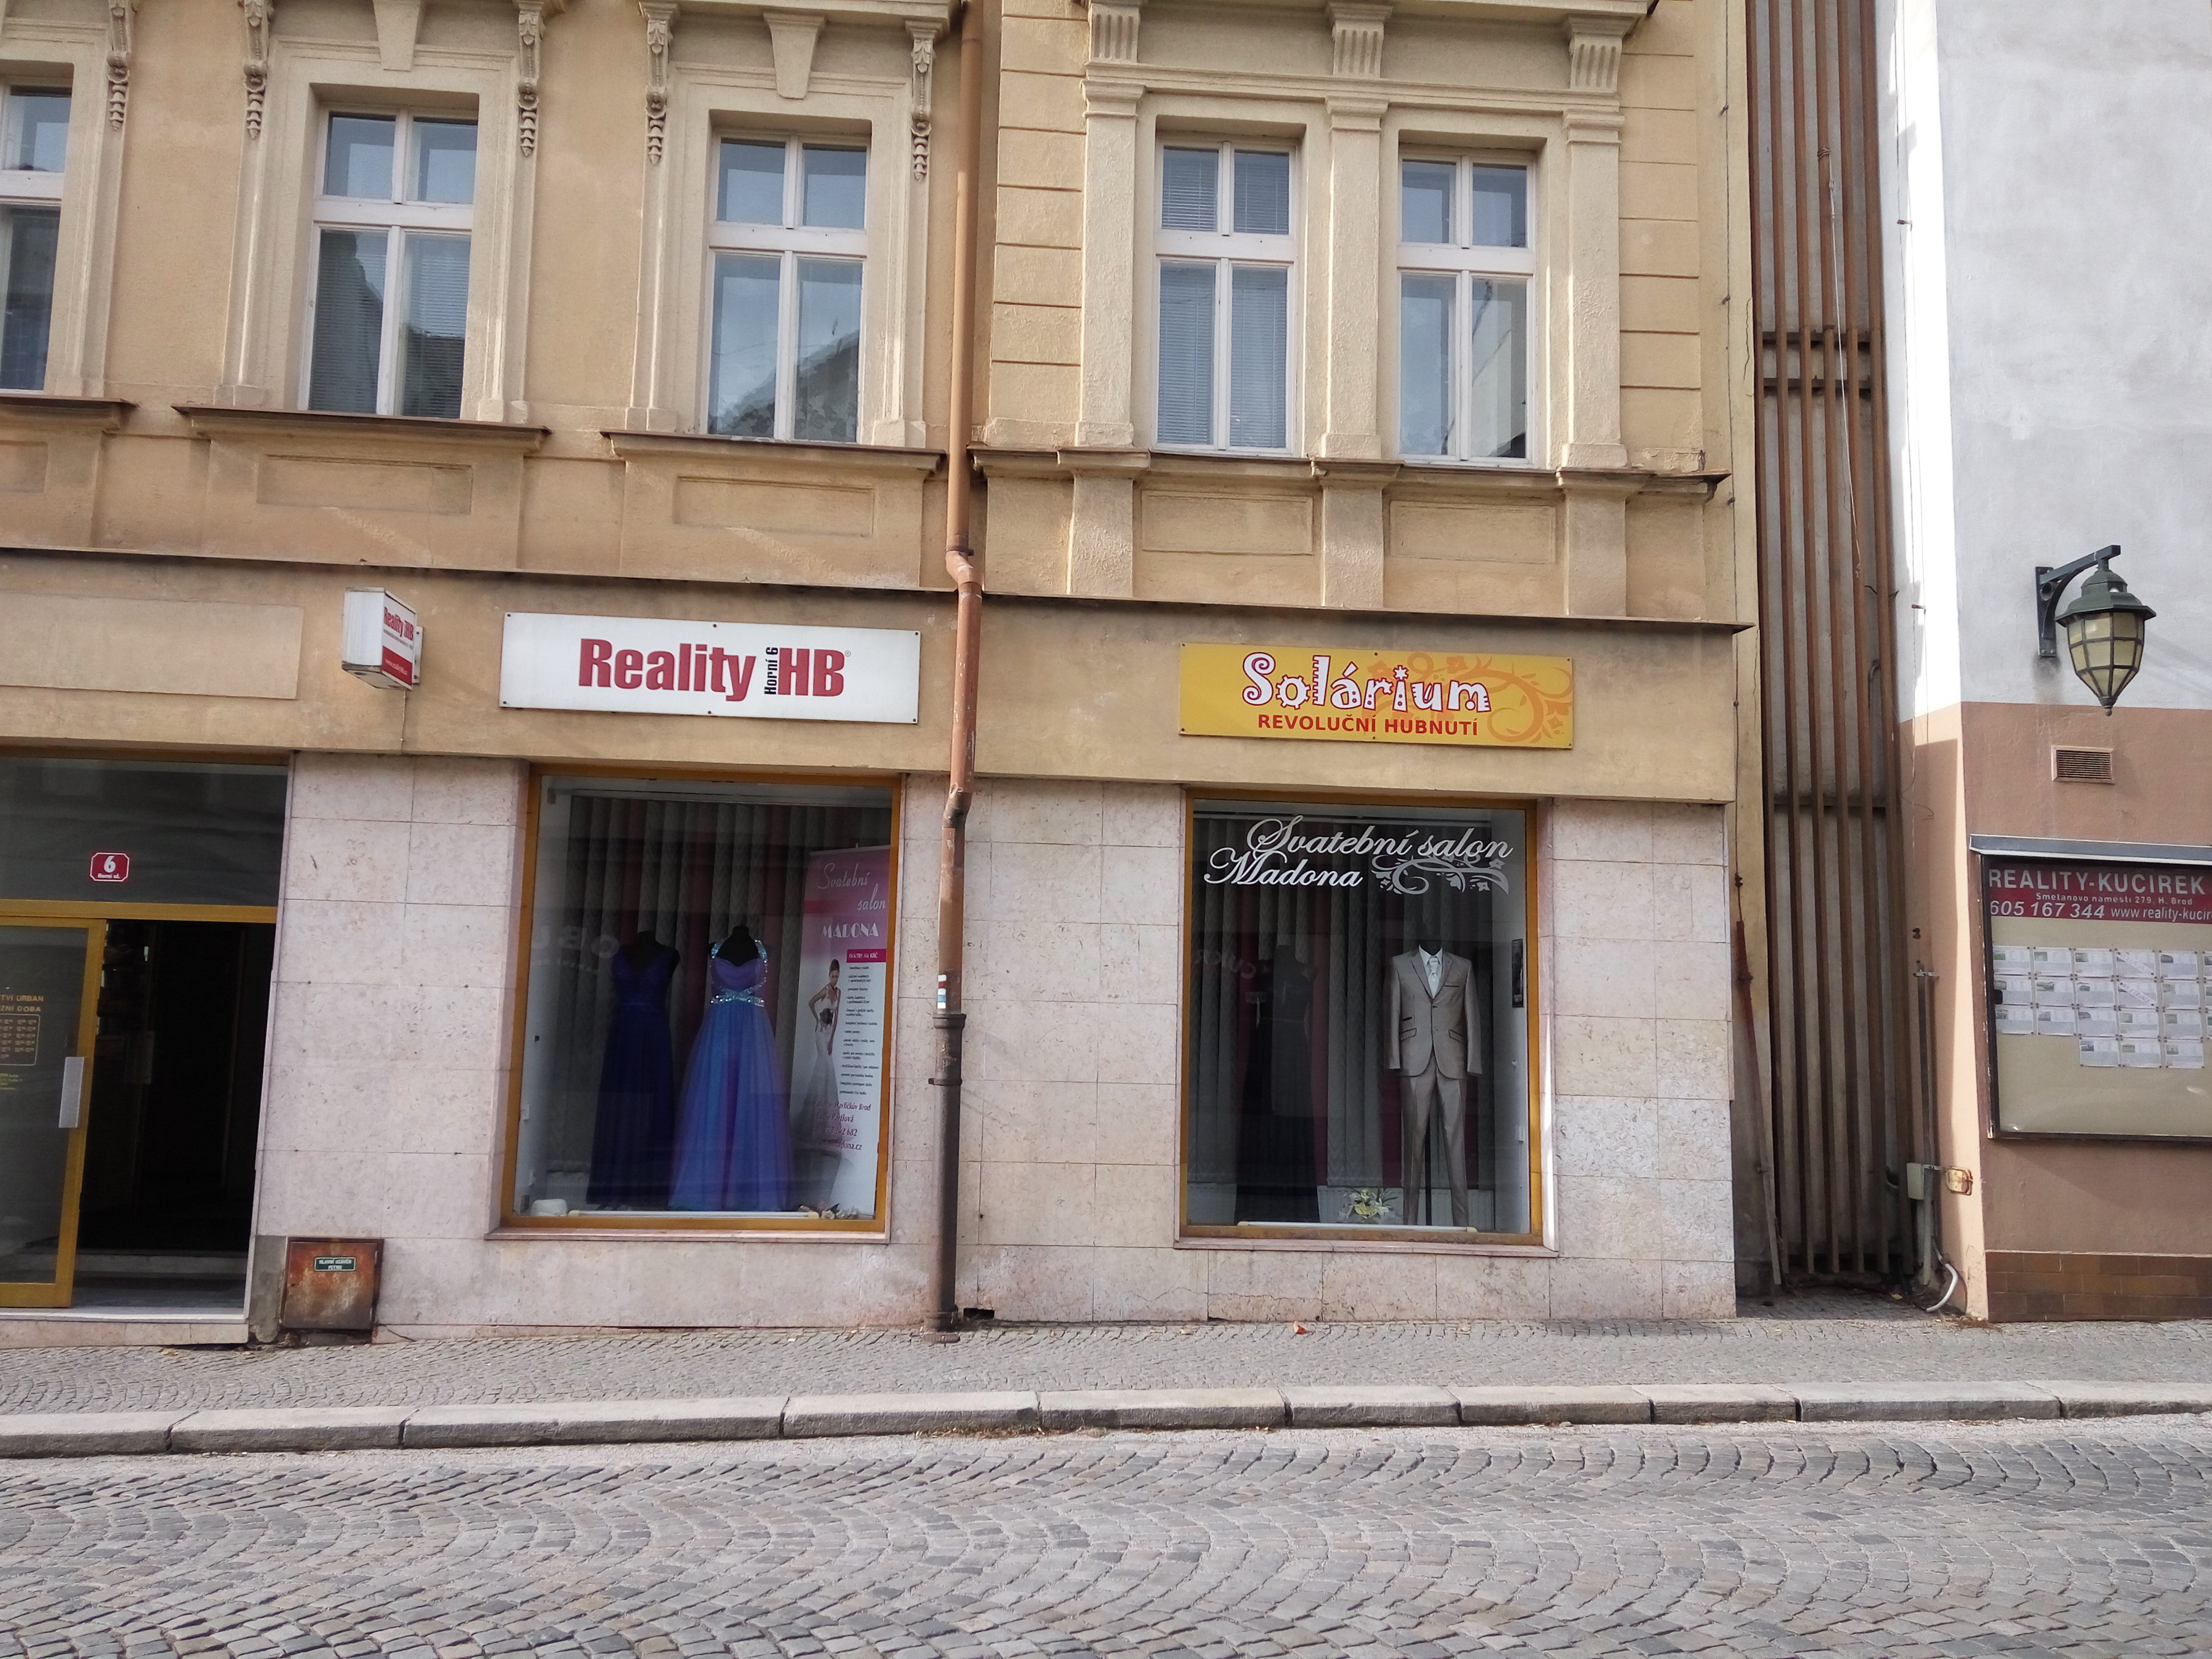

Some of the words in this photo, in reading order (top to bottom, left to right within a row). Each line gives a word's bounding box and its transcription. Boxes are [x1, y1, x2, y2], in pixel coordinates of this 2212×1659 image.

[383, 607, 404, 637] Reality
[578, 638, 756, 702] Reality
[778, 648, 845, 697] HB
[764, 659, 778, 695] Horní
[1242, 651, 1492, 713] Solárium
[1258, 713, 1376, 733] REVOLUČNÍ
[1384, 717, 1478, 736] HUBNUTÍ
[1246, 815, 1418, 857] Svatební
[1418, 828, 1514, 858] salon
[103, 855, 116, 873] 6
[817, 863, 870, 889] Svatební
[1204, 847, 1364, 887] Madona
[857, 883, 886, 910] salon
[2171, 897, 2193, 905] Brod
[1990, 900, 2025, 916] 605
[2031, 901, 2065, 917] 167
[2070, 903, 2105, 919] 344
[2111, 906, 2212, 922] www.reality-kucir
[822, 922, 879, 938] MADONA
[847, 1129, 858, 1137] 682
